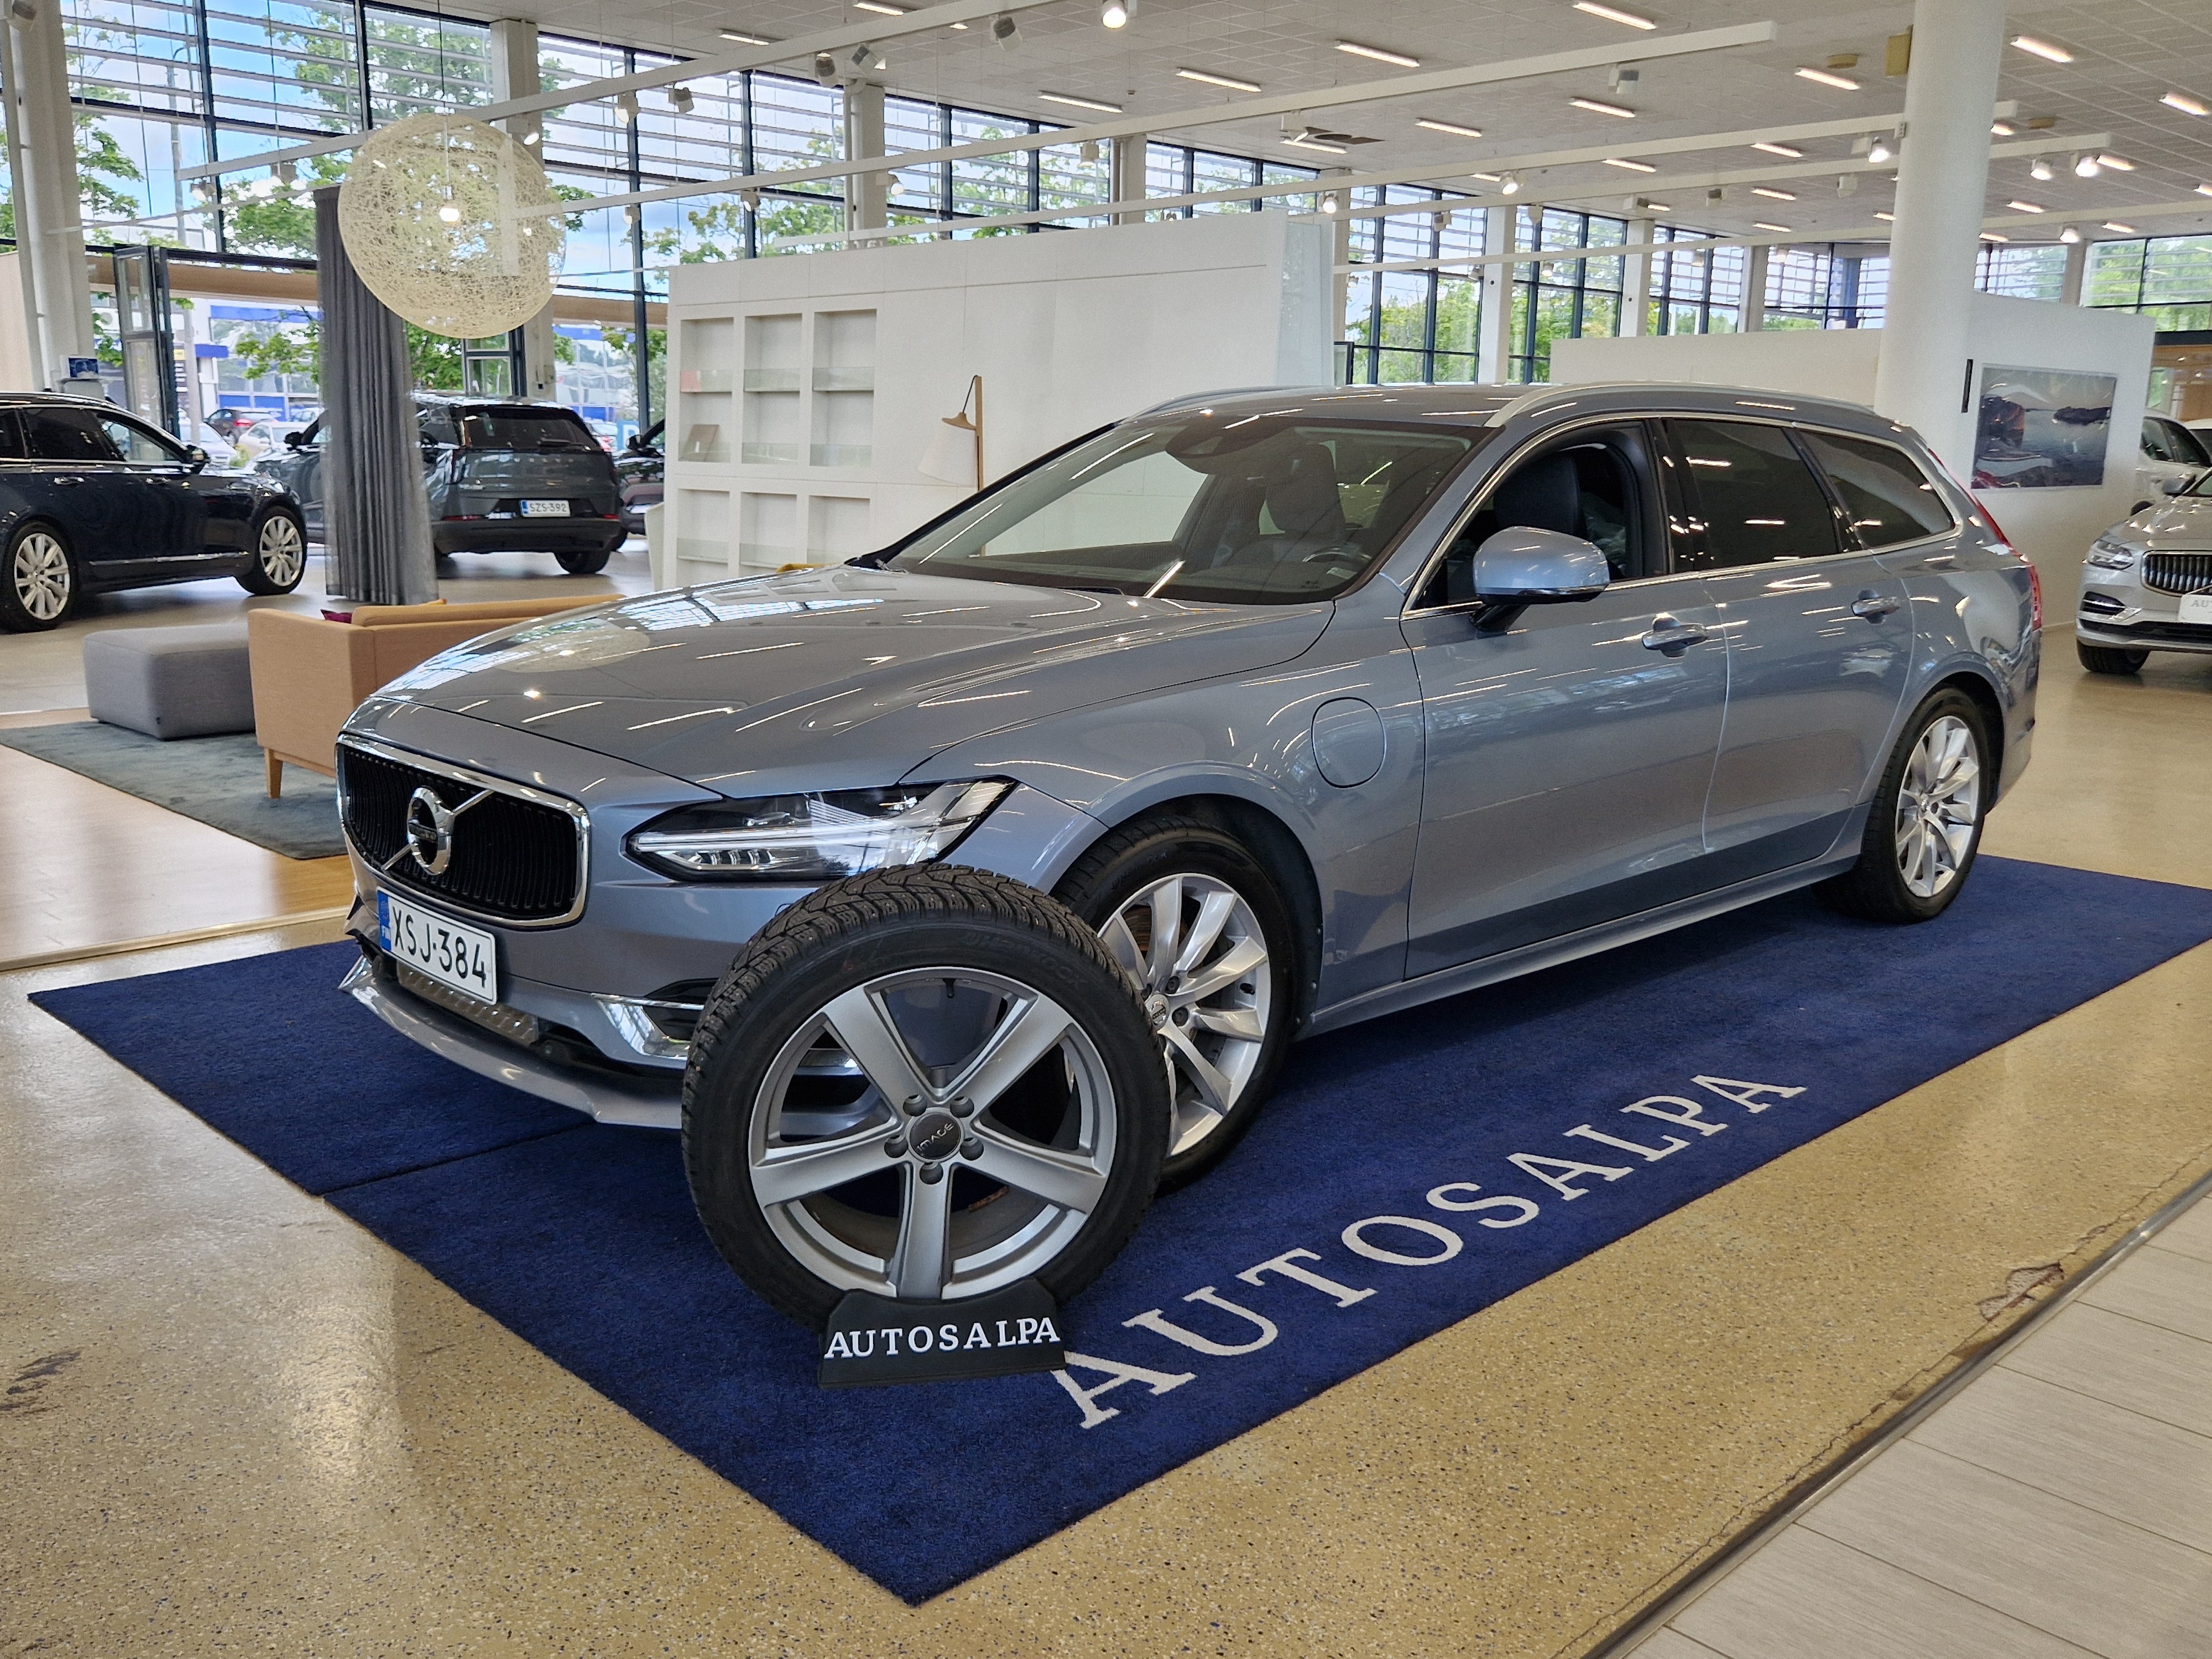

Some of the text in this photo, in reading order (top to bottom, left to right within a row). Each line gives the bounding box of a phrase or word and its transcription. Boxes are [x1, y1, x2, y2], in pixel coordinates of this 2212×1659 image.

[529, 503, 566, 512] SZS-392
[2190, 599, 2212, 608] AU
[392, 905, 487, 989] XSJ-384
[1050, 1074, 1807, 1430] AUTOSALPA
[823, 1317, 1061, 1359] AUTOSALPA
